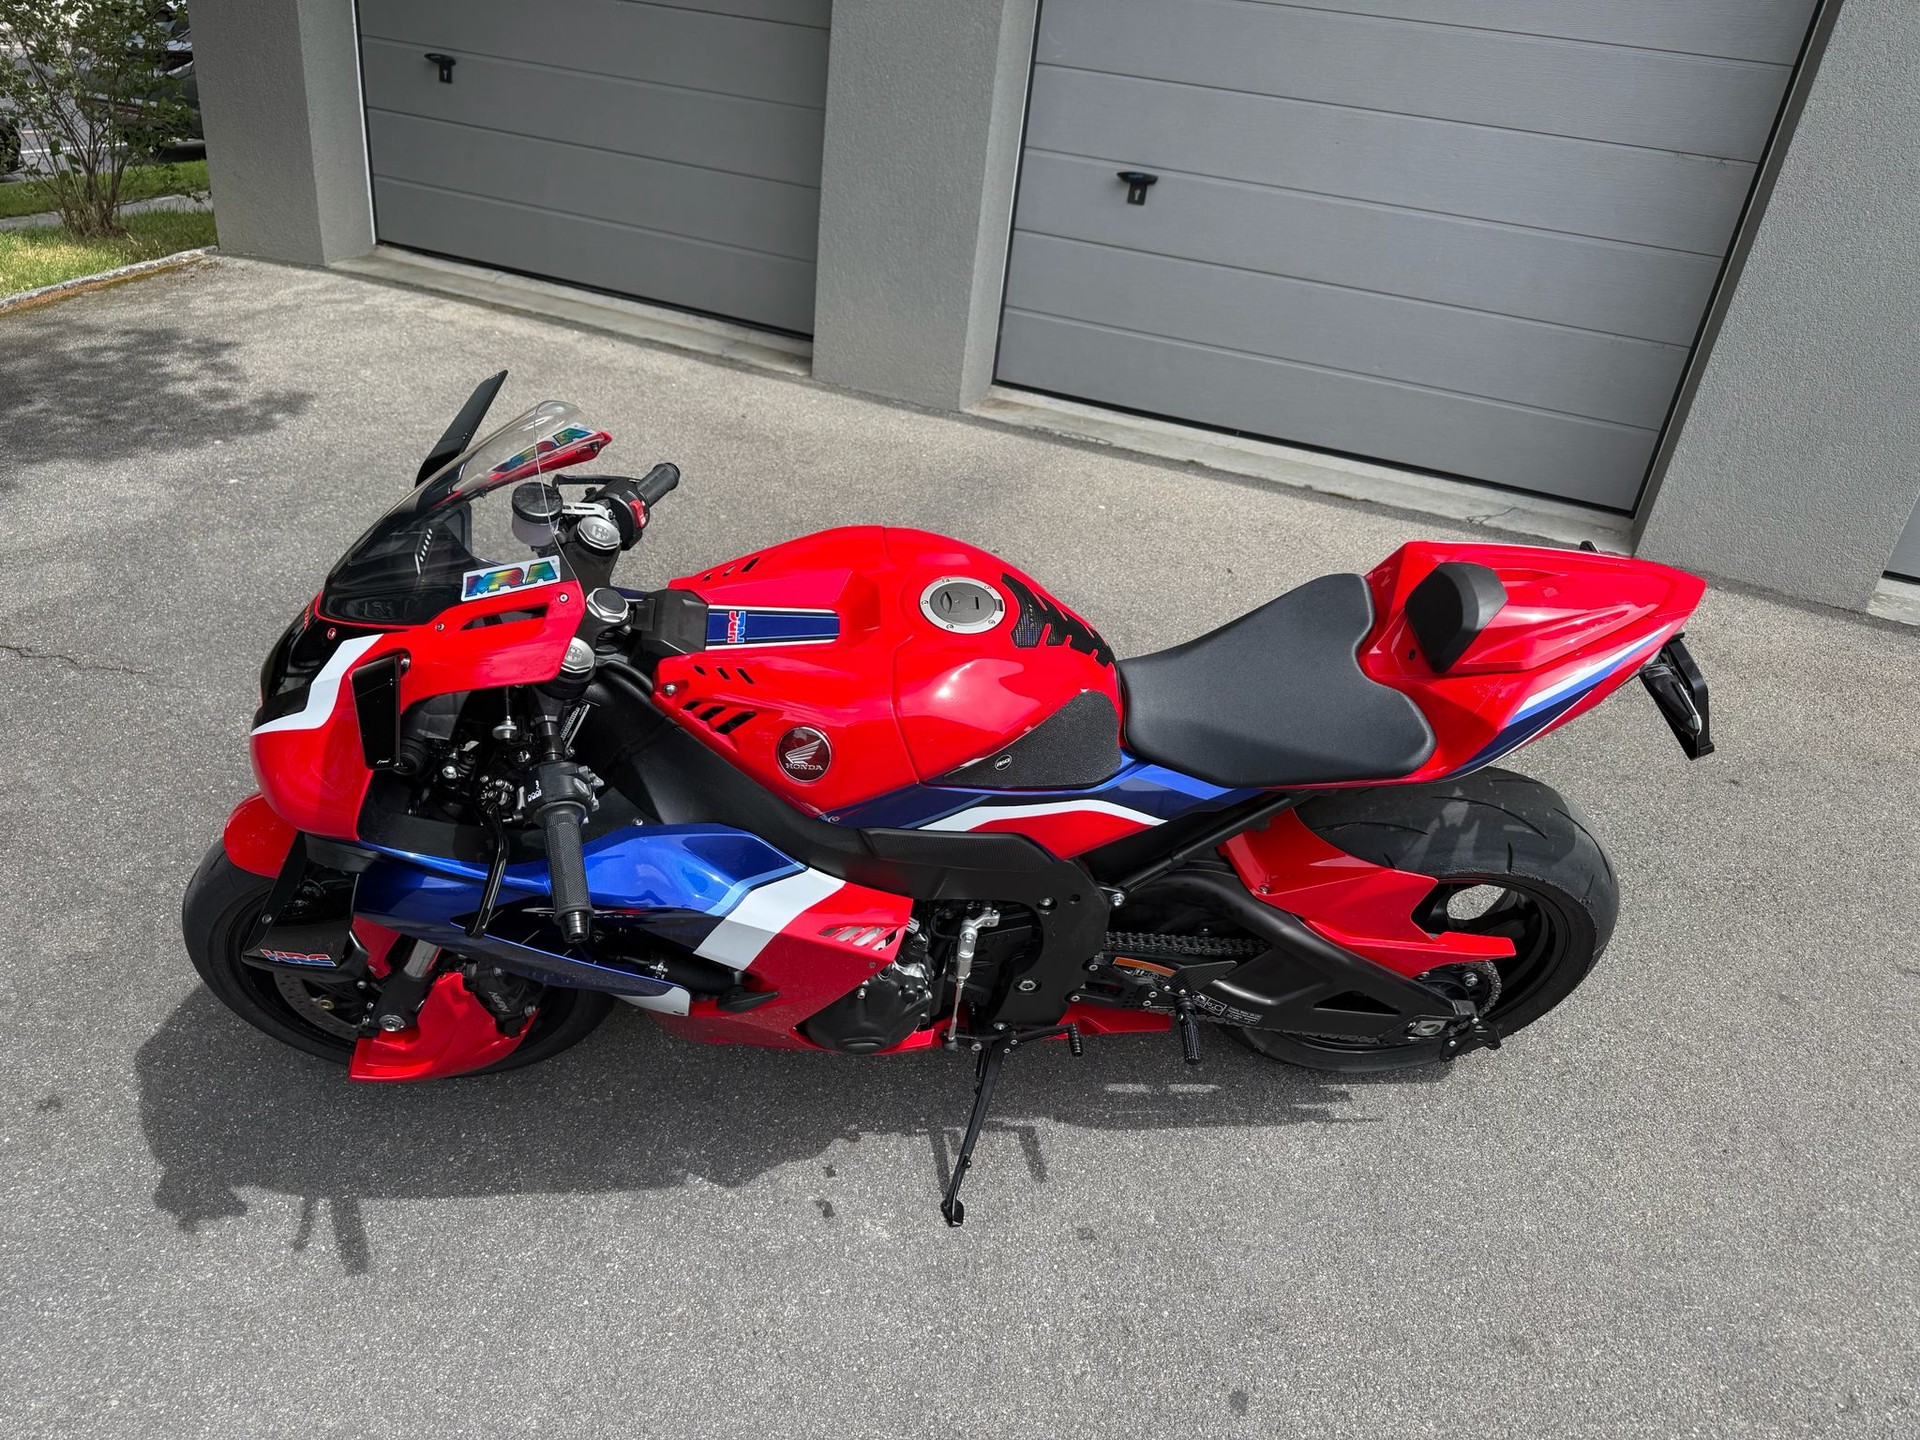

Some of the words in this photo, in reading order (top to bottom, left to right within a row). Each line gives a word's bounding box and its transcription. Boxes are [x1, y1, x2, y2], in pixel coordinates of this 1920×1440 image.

[464, 560, 558, 598] MRA
[727, 610, 747, 643] HRC
[785, 762, 824, 771] HONDA
[260, 948, 337, 967] HRC
